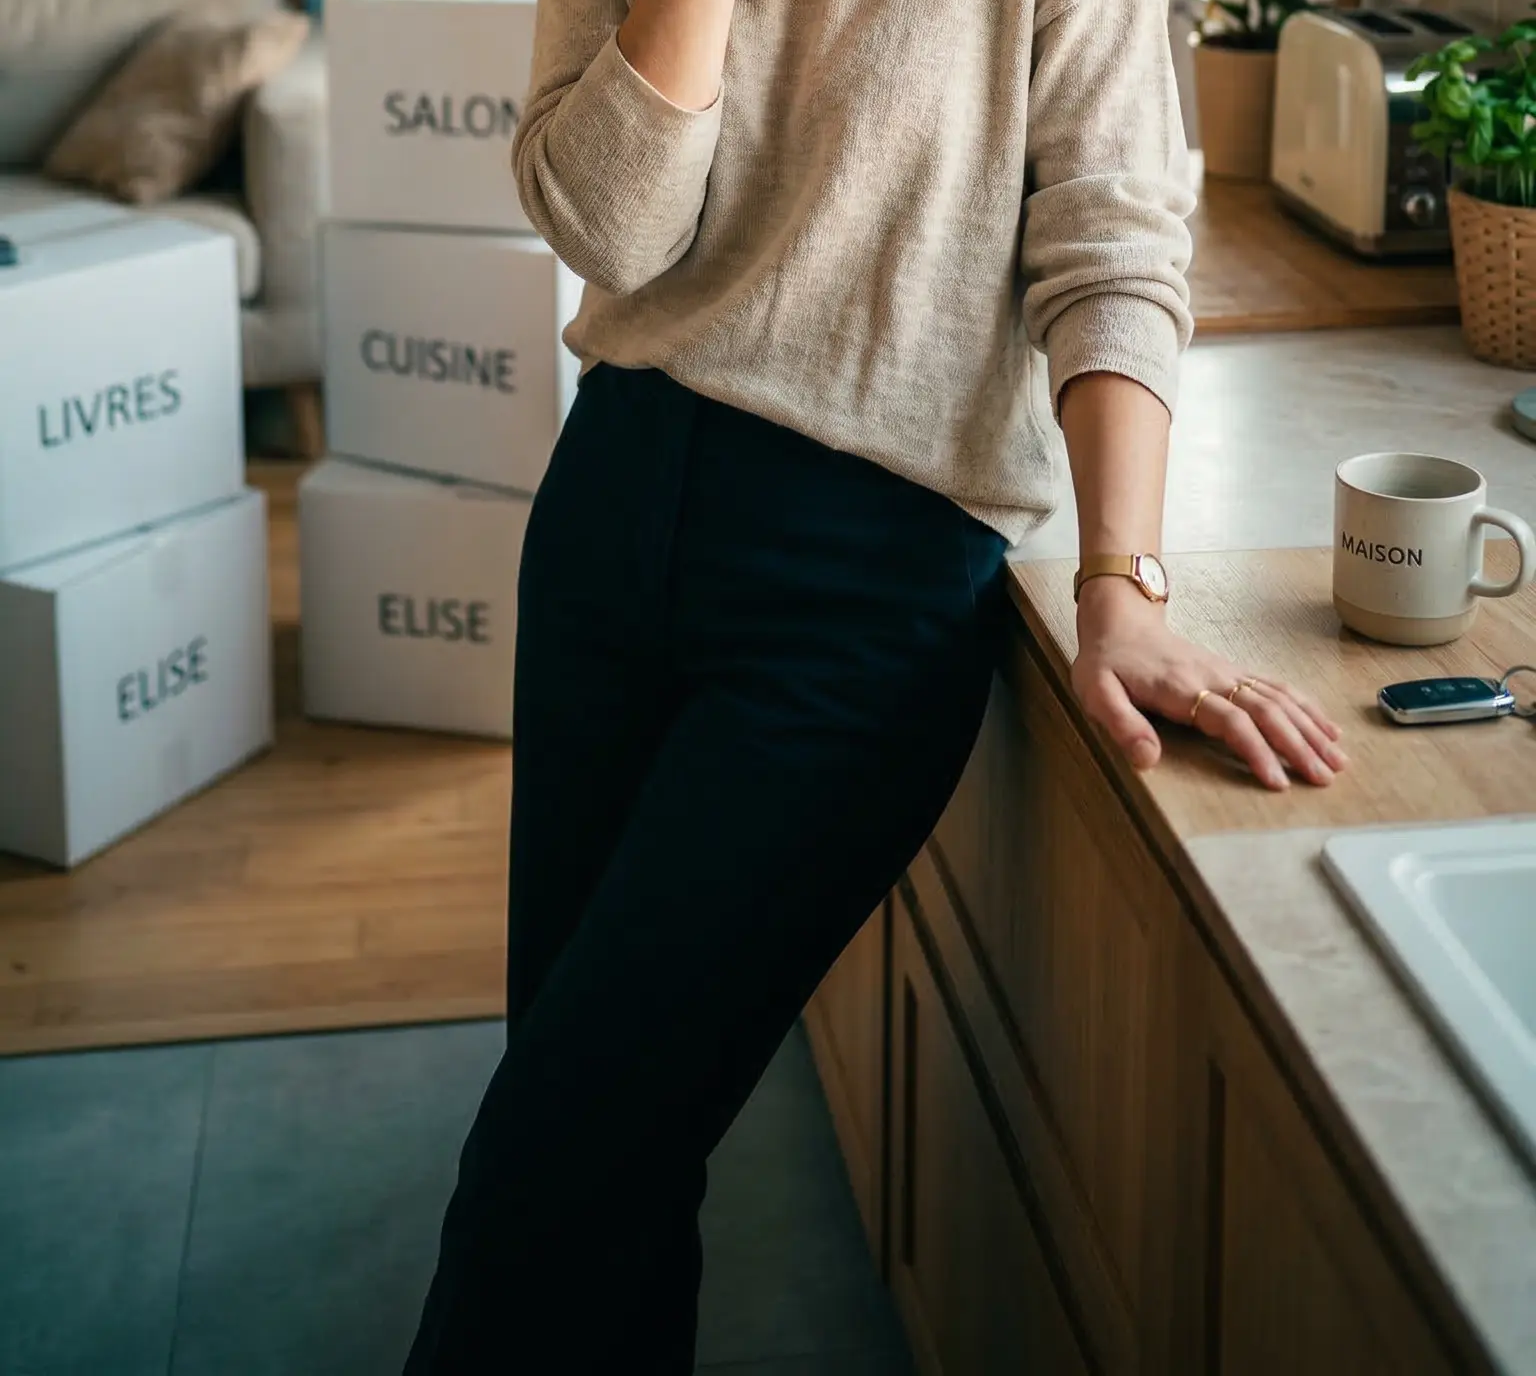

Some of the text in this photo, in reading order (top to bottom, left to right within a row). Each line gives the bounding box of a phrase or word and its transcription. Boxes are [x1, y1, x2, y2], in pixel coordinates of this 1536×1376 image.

[361, 329, 517, 393] CUISINE
[37, 368, 182, 449] LIVRES
[1341, 531, 1423, 567] MAISON
[377, 593, 491, 643] ELISE
[116, 634, 209, 723] ELISE
